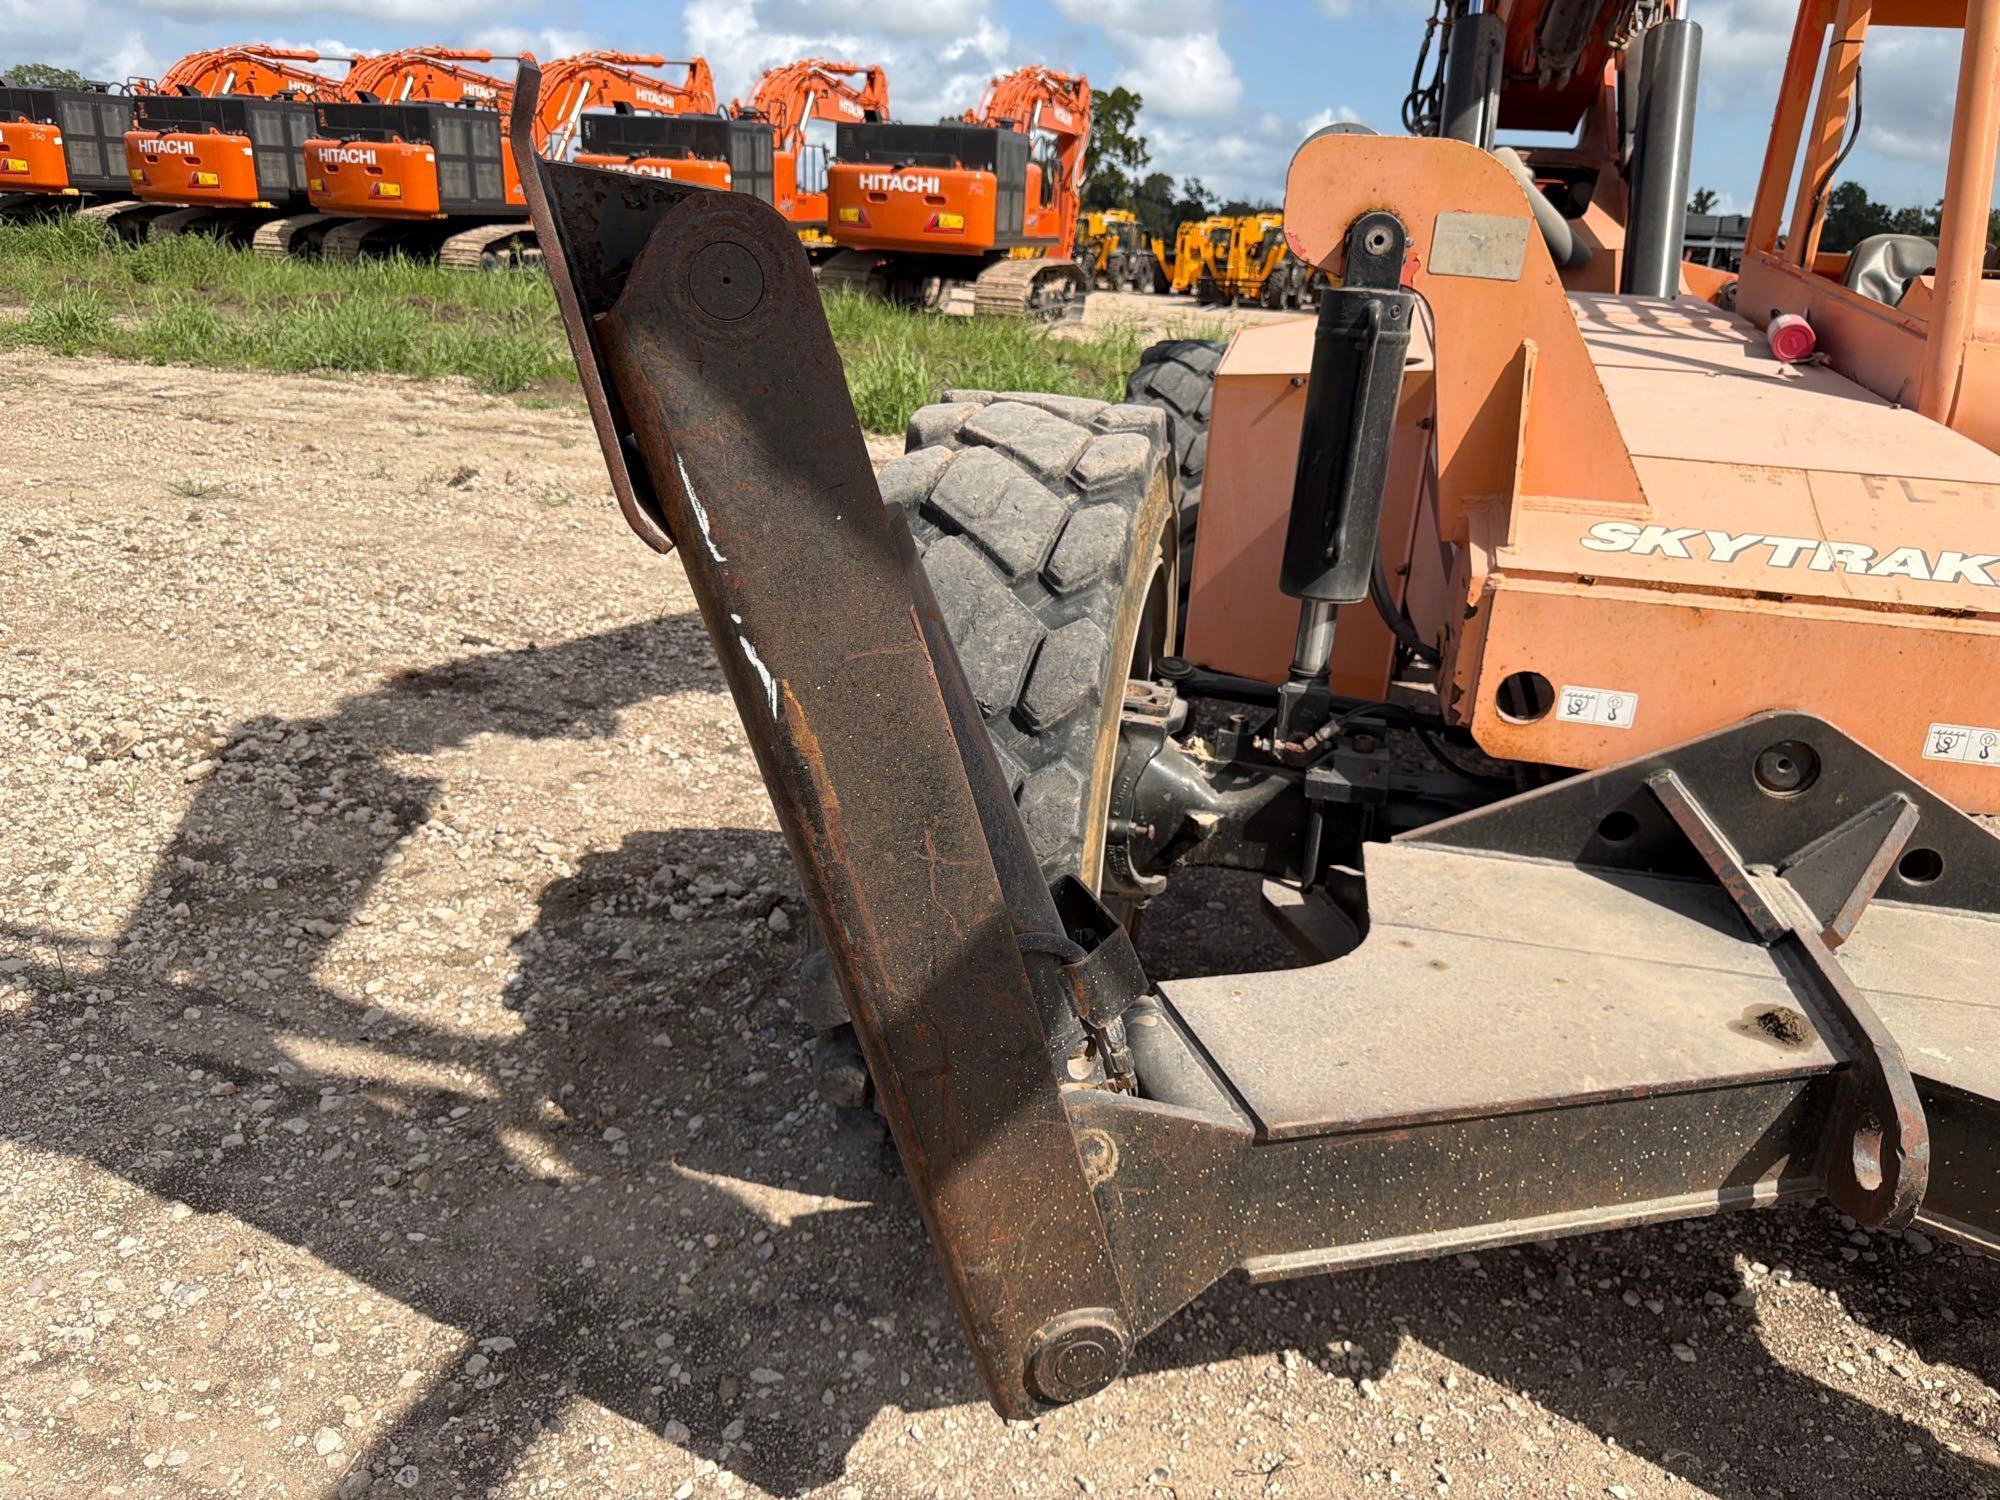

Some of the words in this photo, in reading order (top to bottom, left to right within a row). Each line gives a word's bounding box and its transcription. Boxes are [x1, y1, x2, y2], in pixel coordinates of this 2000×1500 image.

[635, 87, 675, 109] HITACHI
[29, 131, 46, 141] 350
[138, 140, 194, 155] HITACHI
[318, 148, 377, 165] HITACHI
[859, 173, 940, 194] HITACHI
[1579, 521, 2000, 588] SKYTRAK
